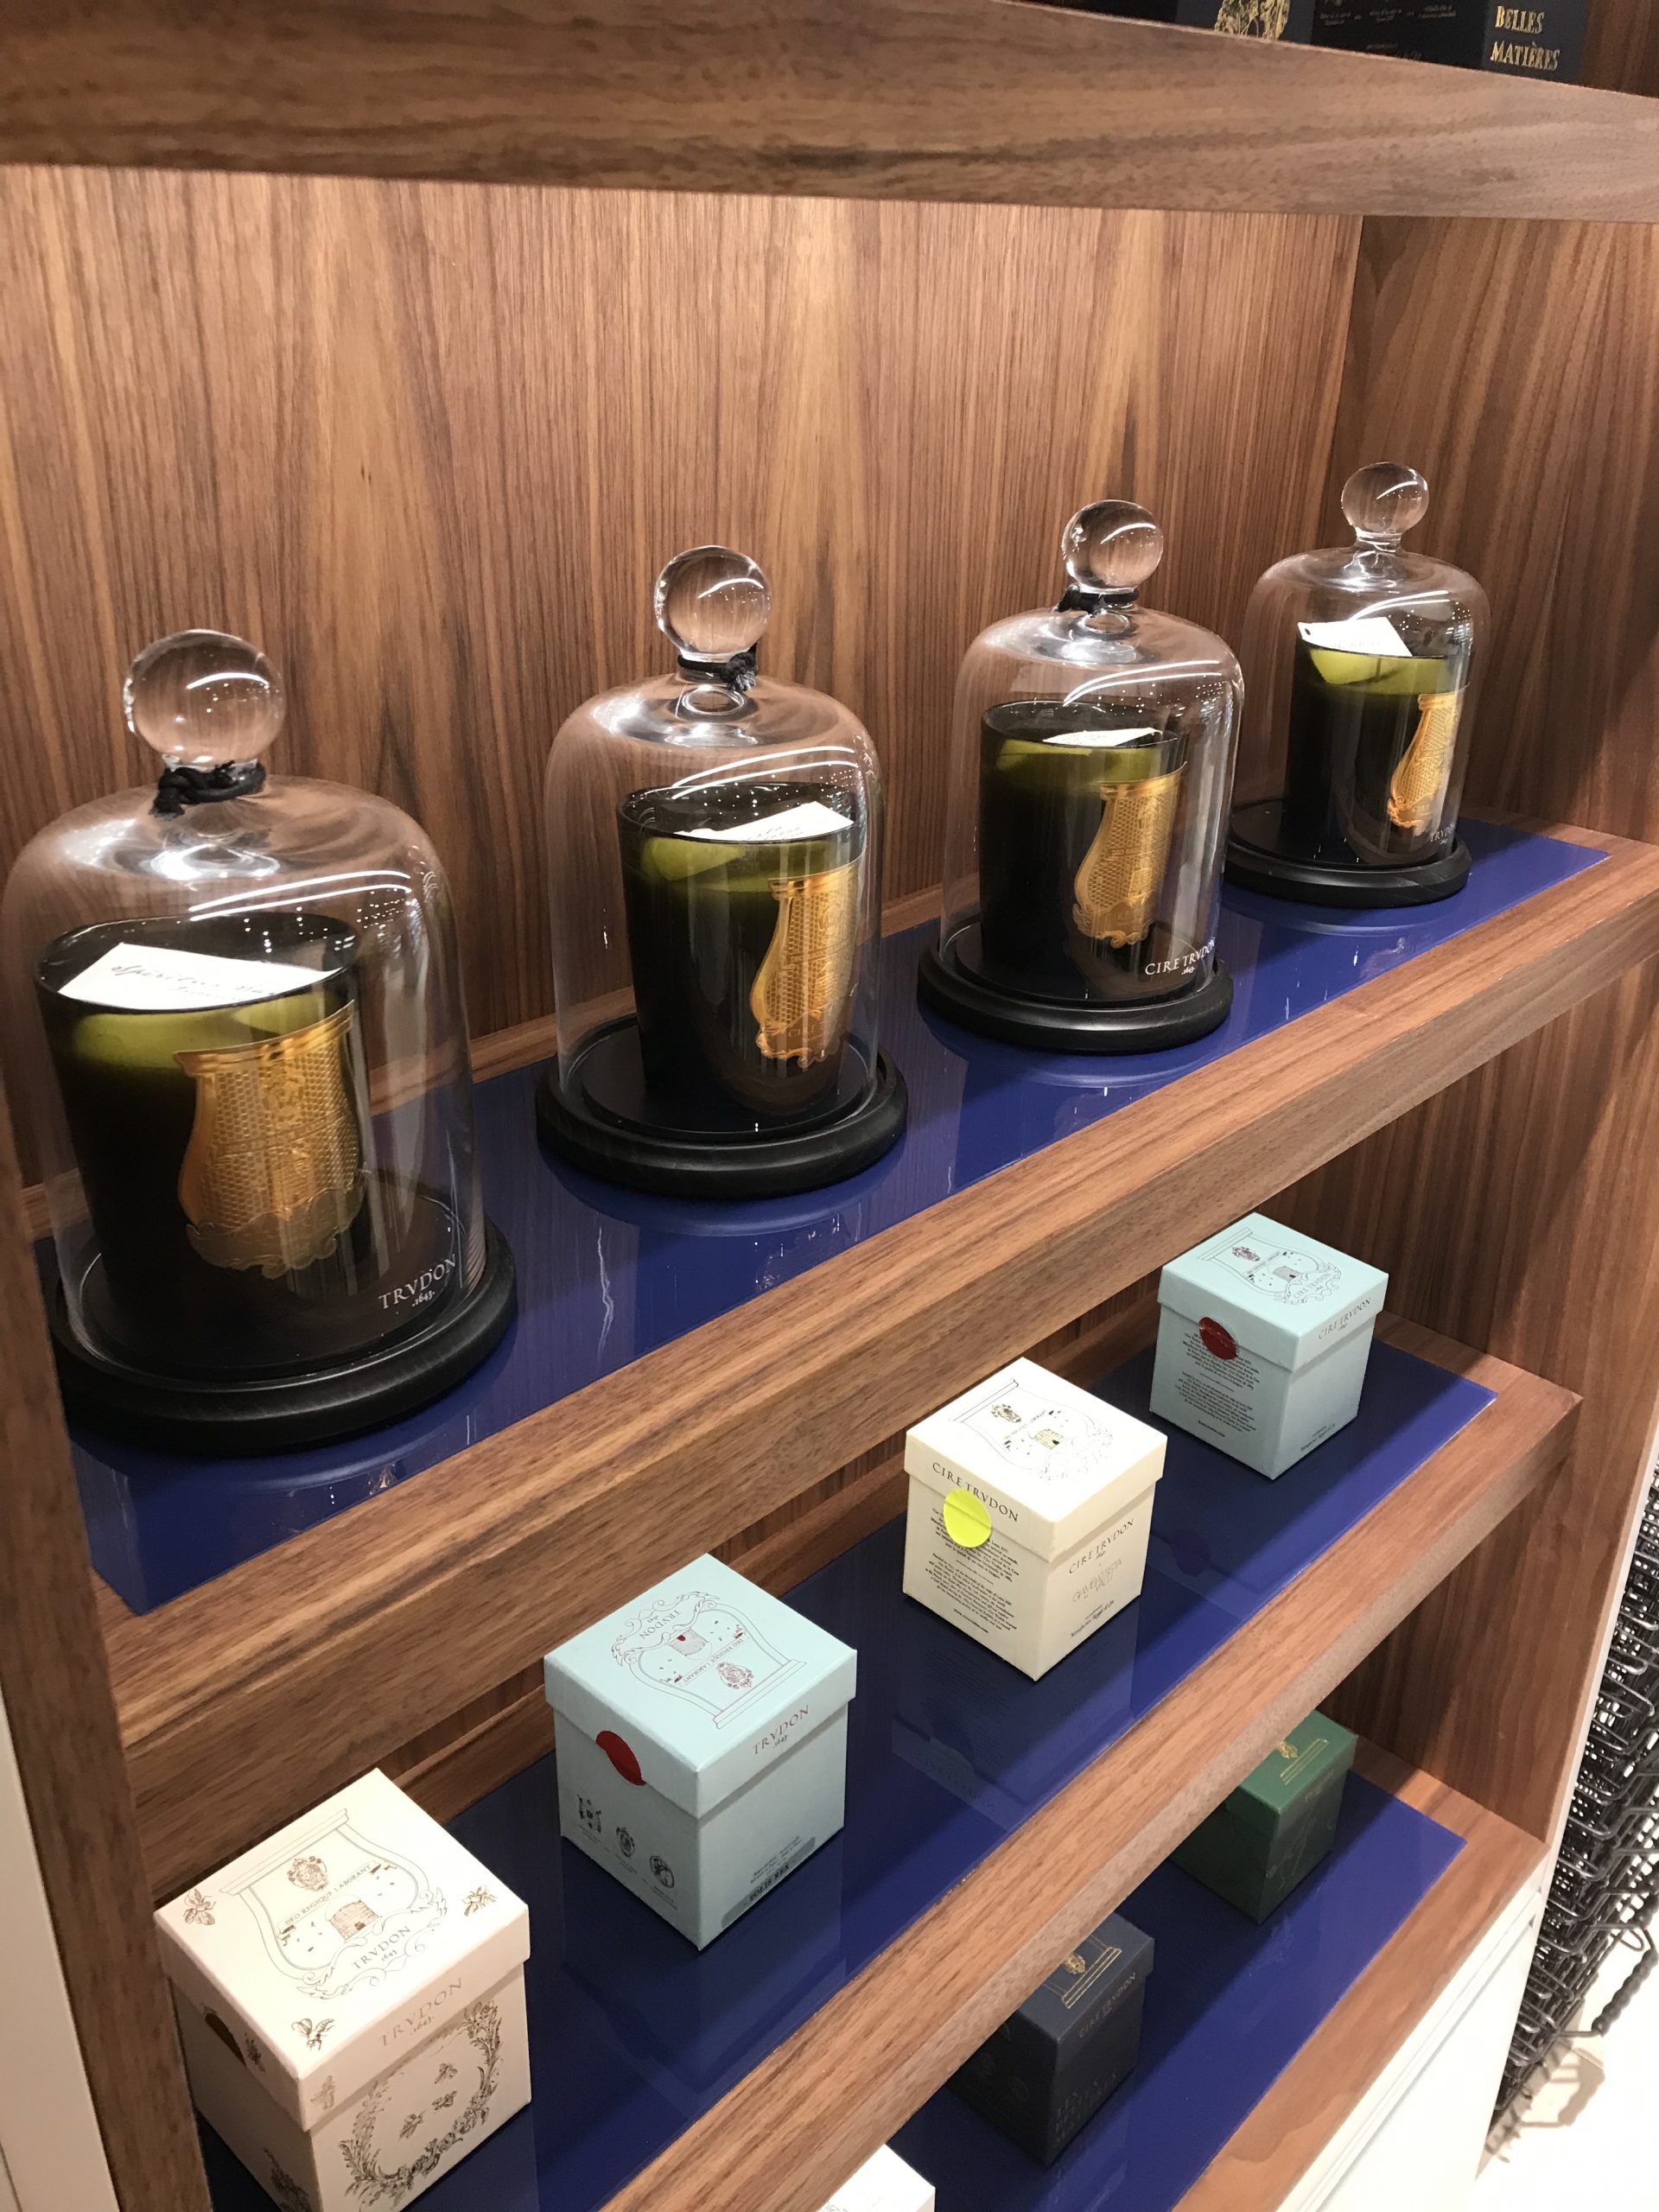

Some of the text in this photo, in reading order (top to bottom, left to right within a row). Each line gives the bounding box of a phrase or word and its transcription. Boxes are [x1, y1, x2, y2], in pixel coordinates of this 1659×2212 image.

[1495, 5, 1545, 35] BELLES
[1490, 40, 1560, 71] MATIÈRES
[1145, 958, 1180, 976] CIRE
[932, 1462, 963, 1488] CIRE
